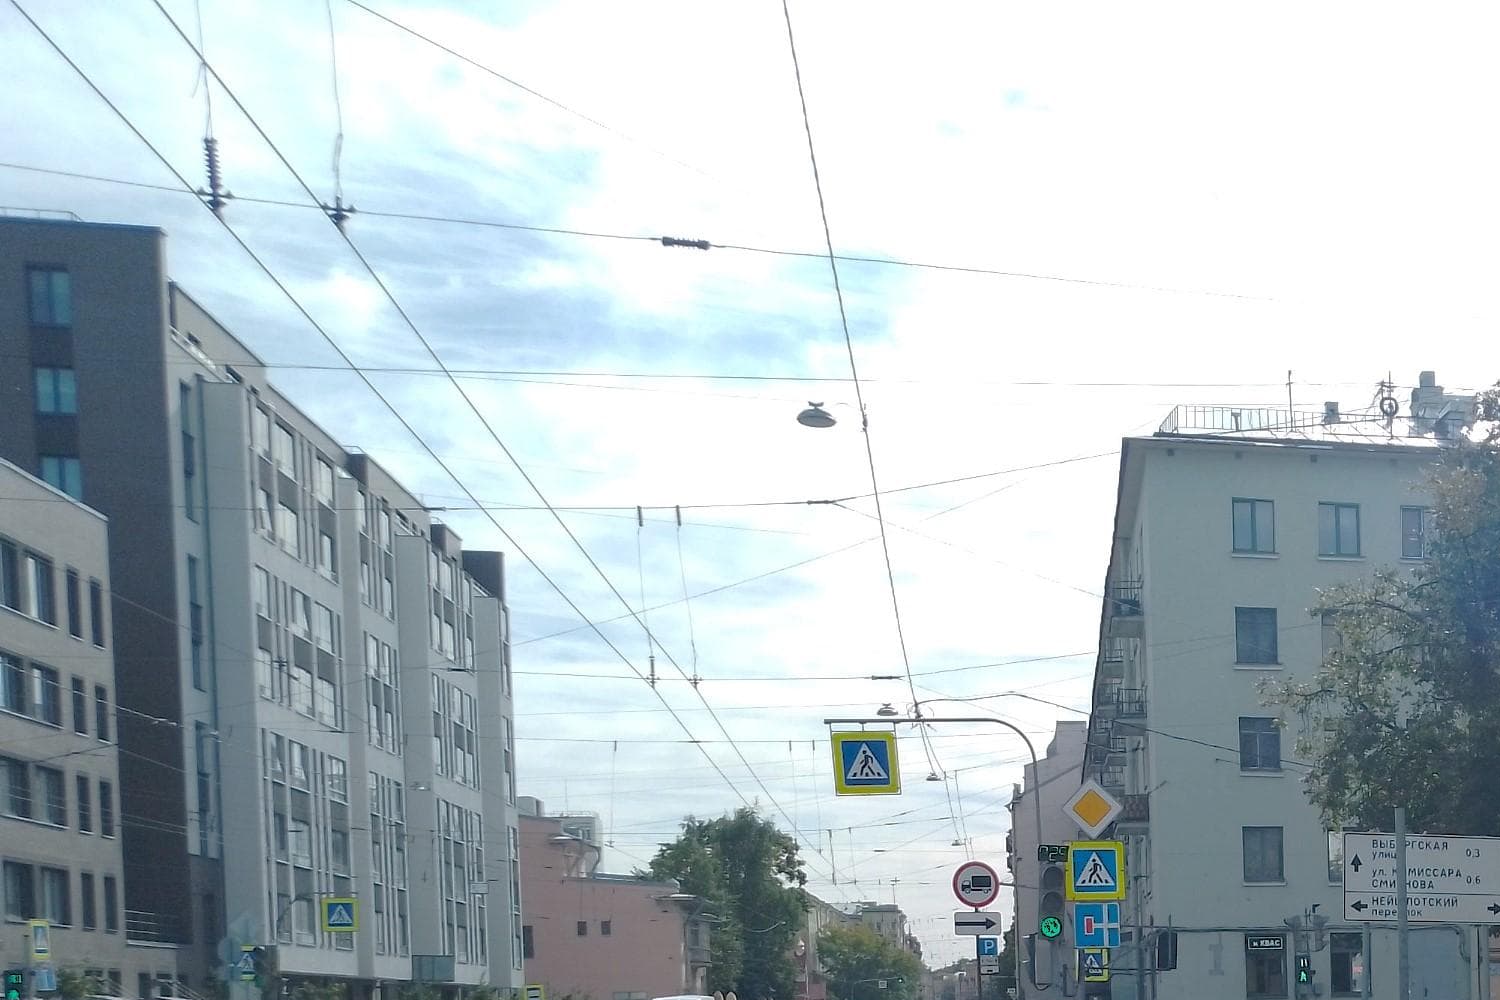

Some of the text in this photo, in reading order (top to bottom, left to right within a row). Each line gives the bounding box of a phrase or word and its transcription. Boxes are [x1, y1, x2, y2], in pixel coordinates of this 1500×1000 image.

[1372, 839, 1448, 851] ВЫБРГСКАЯ
[1372, 851, 1398, 861] улиц
[1392, 868, 1462, 878] КМИССАРА
[1371, 879, 1435, 889] СМИНОВА
[1371, 895, 1458, 908] НЕЙЛОТСКИЙ
